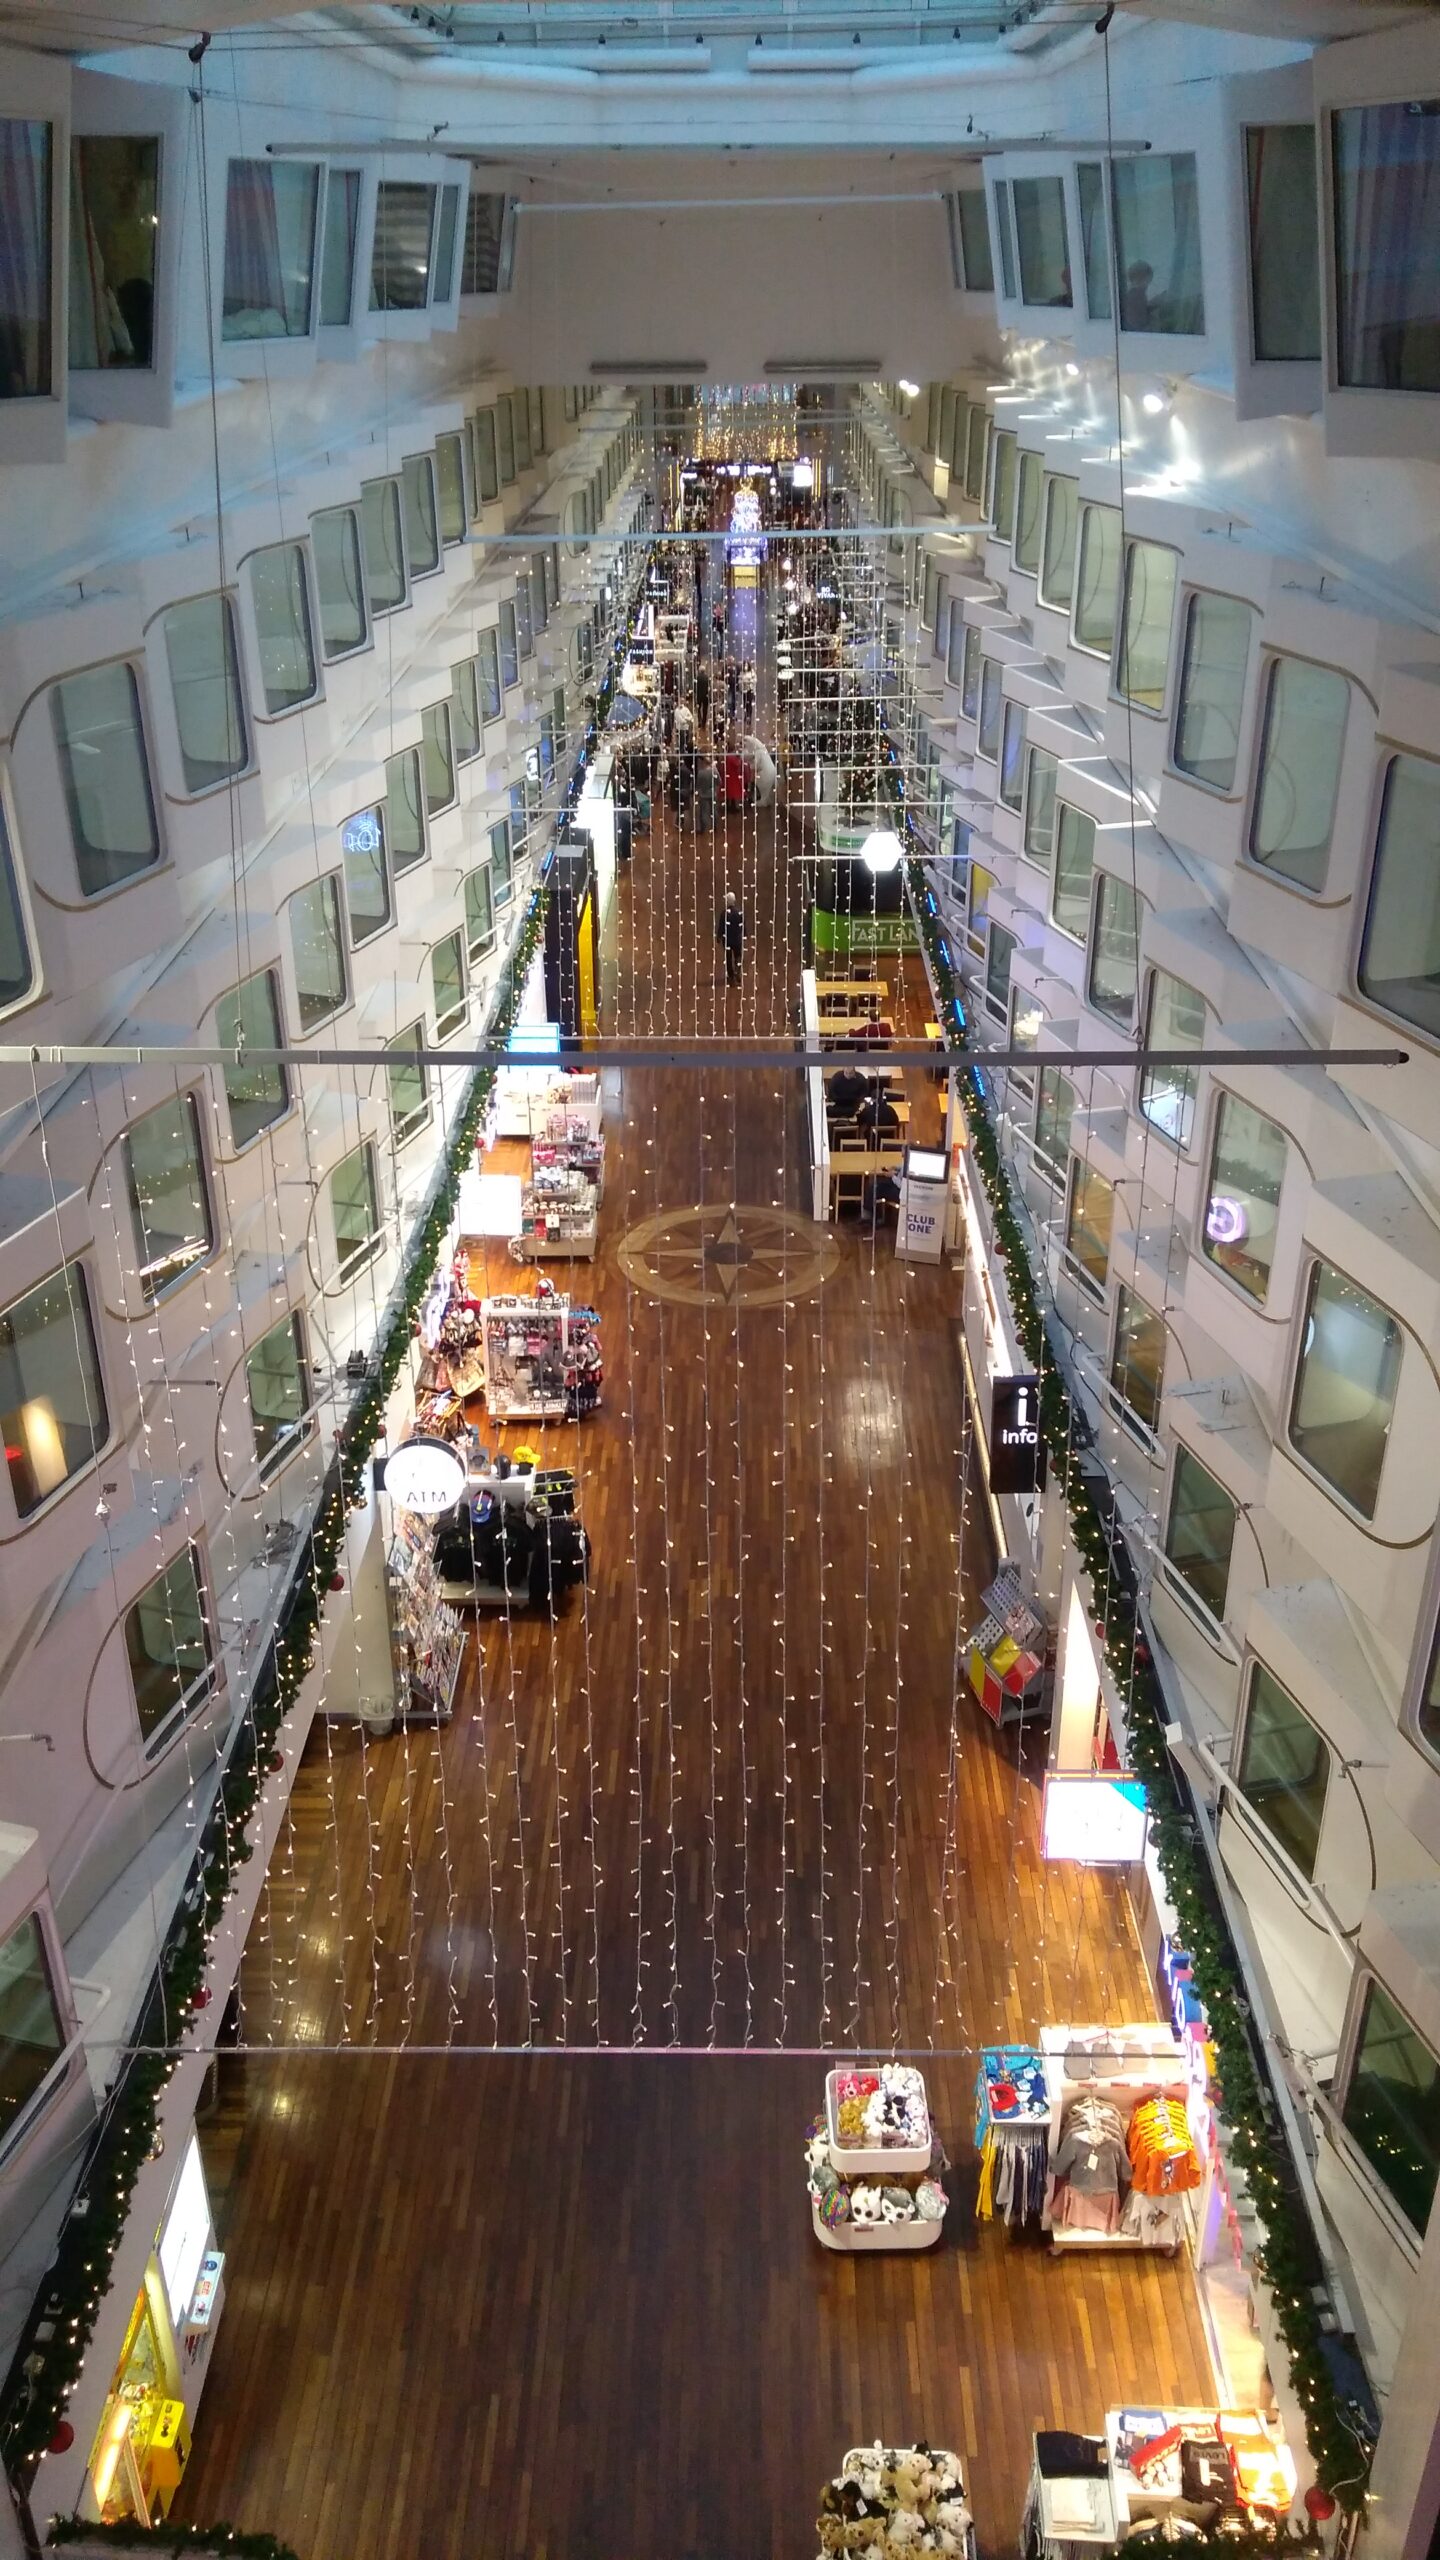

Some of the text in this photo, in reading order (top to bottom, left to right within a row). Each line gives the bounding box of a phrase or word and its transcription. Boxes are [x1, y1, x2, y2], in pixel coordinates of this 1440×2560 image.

[852, 921, 919, 942] FAST LAN
[906, 1213, 936, 1226] CLUB
[908, 1223, 932, 1235] ONE
[1002, 1428, 1038, 1445] info
[406, 1490, 447, 1503] ATM
